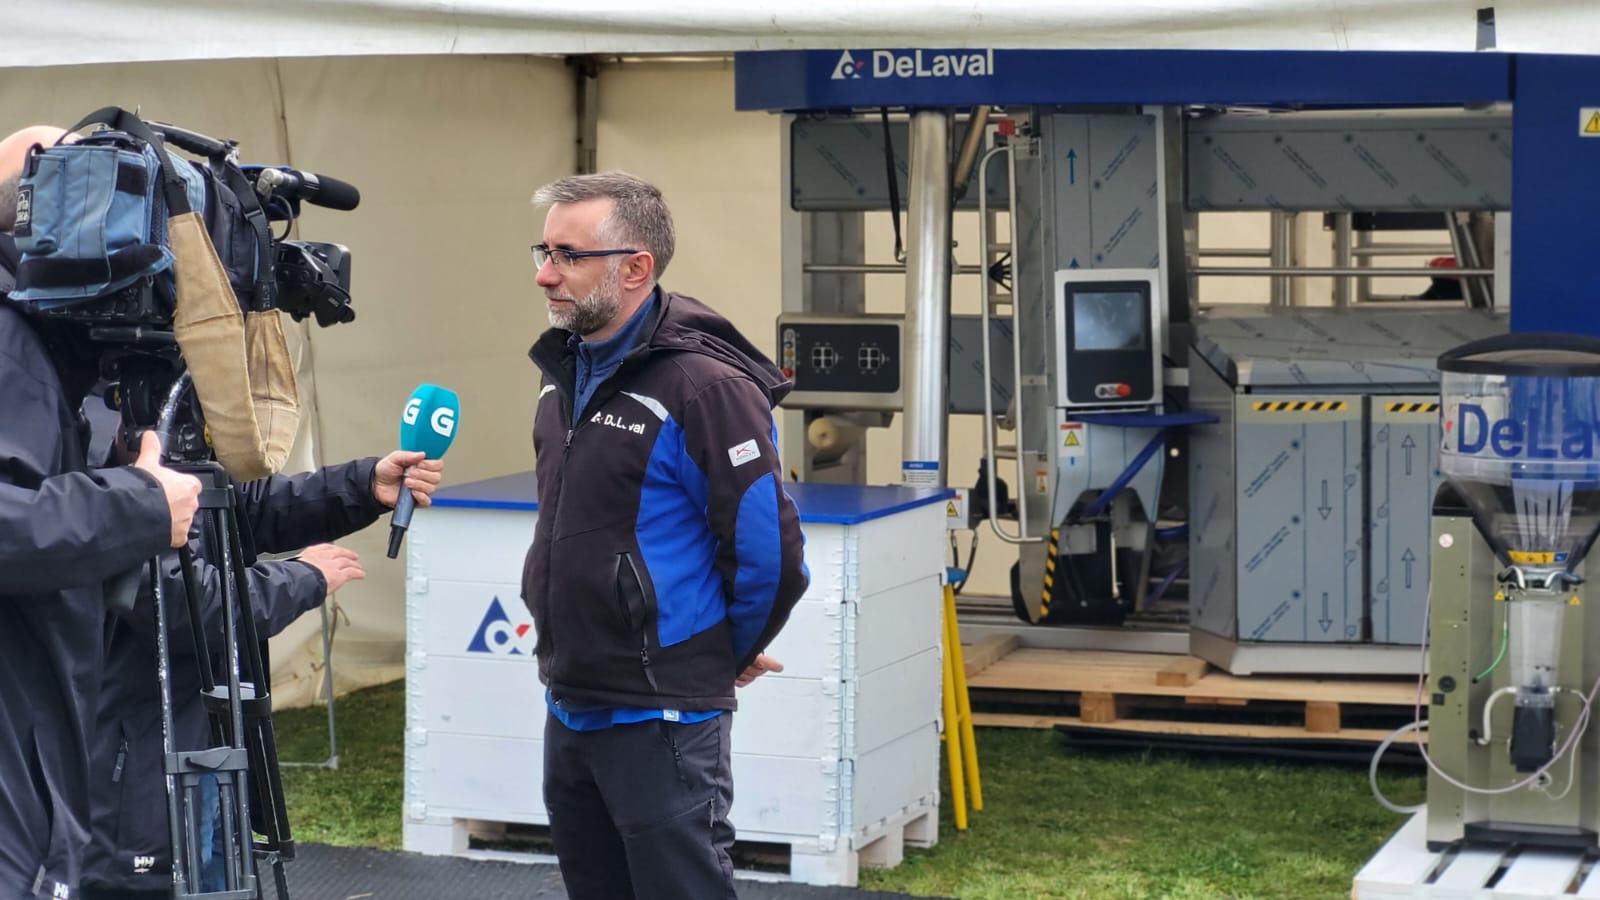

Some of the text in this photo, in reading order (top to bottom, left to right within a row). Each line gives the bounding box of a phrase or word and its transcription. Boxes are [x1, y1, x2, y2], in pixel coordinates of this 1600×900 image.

[872, 48, 994, 78] DeLaval
[403, 397, 422, 425] G
[431, 407, 454, 437] G
[1457, 402, 1600, 460] DeLa
